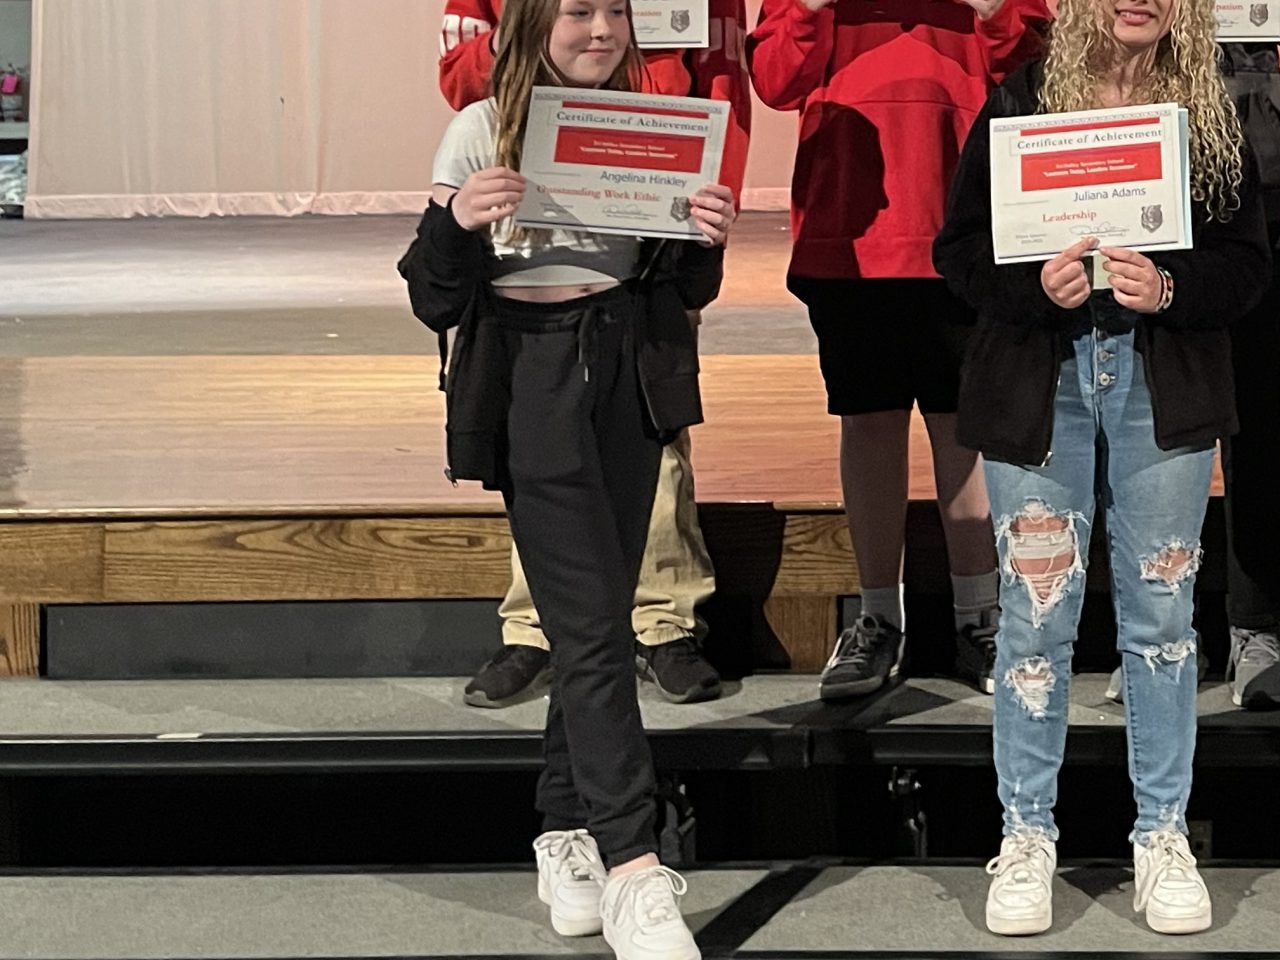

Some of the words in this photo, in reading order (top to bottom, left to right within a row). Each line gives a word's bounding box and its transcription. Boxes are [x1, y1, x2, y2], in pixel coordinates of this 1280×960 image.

[1216, 3, 1243, 13] passion
[557, 112, 616, 125] Certificate
[637, 119, 708, 132] Achievement
[1017, 138, 1072, 149] Certificate
[1093, 130, 1162, 142] Achievement
[600, 171, 645, 185] Angelina
[650, 175, 688, 188] Hinkley
[537, 186, 600, 200] Outstanding
[604, 190, 630, 200] Work
[634, 192, 660, 202] Ethic
[1073, 191, 1108, 202] Juliana
[1112, 187, 1146, 197] Adams
[1043, 210, 1096, 223] Leadership
